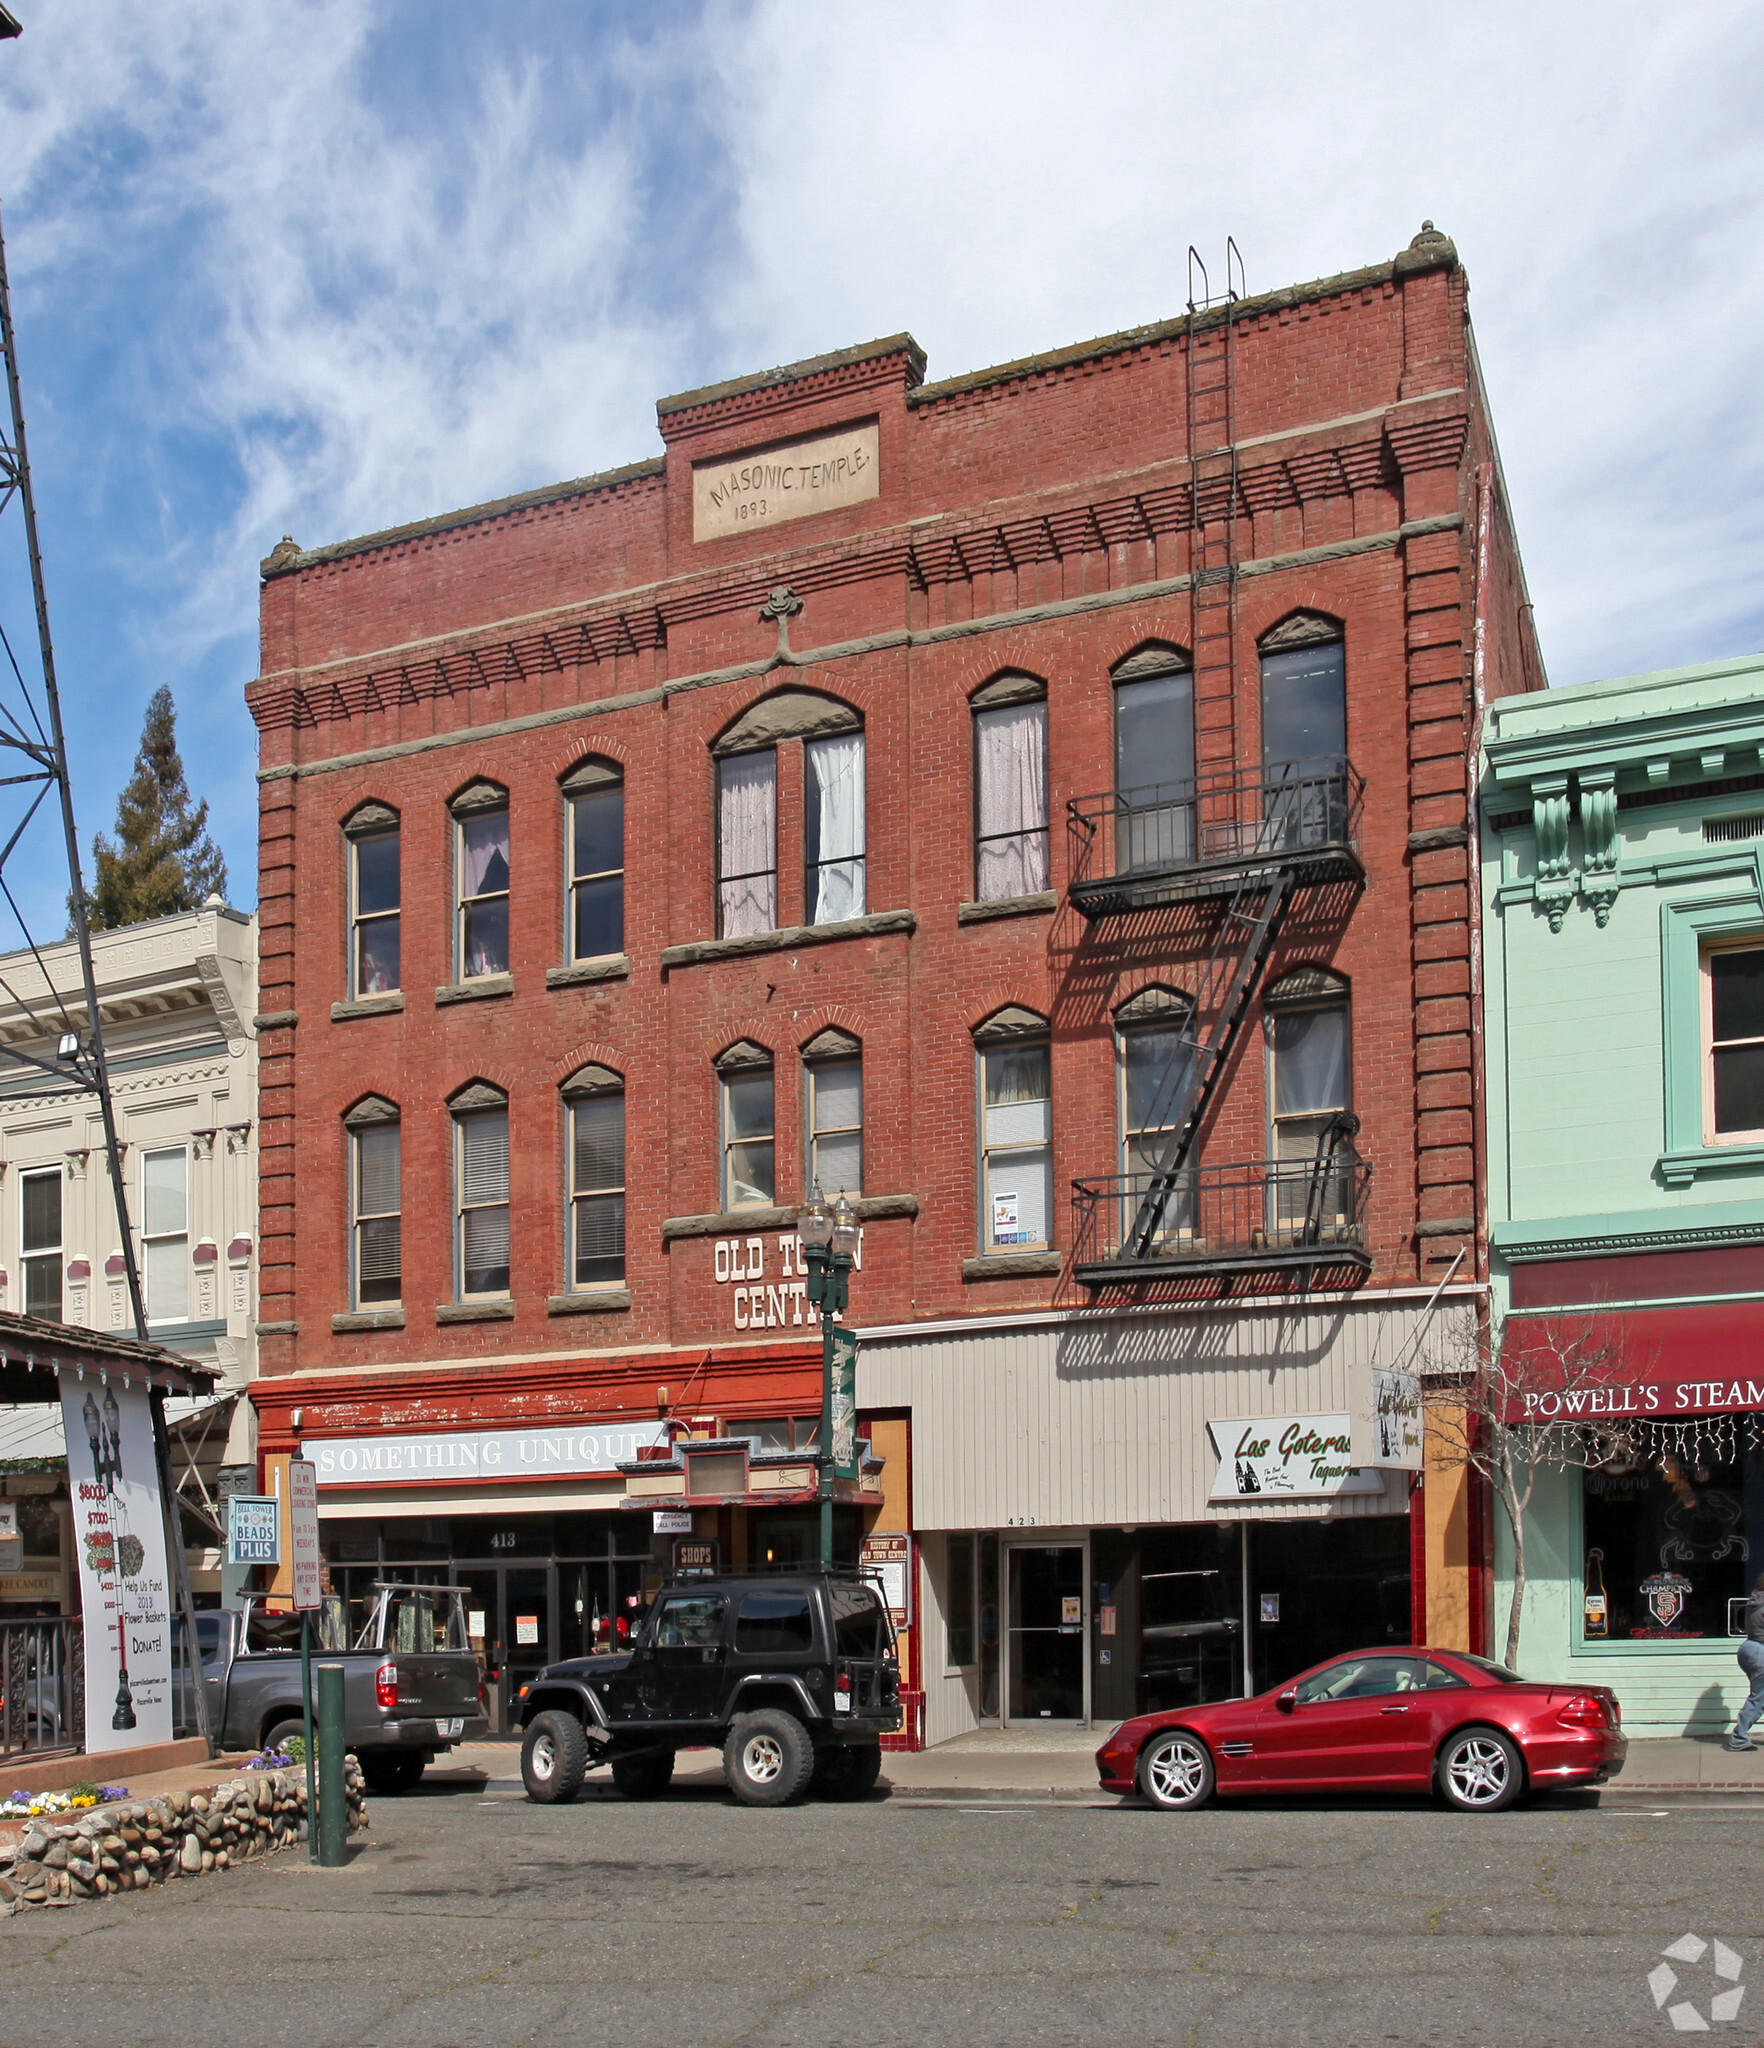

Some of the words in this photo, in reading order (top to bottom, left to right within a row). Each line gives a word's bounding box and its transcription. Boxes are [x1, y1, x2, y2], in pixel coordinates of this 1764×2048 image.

[714, 1237, 764, 1283] OLD
[778, 1227, 864, 1278] TON
[734, 1282, 843, 1330] CENT
[1523, 1385, 1659, 1417] POWELL'S
[1234, 1426, 1271, 1459] Las
[320, 1441, 502, 1473] SOMETHING
[519, 1433, 648, 1464] UNIQUE
[293, 1486, 314, 1496] COMMERCIAL
[237, 1505, 251, 1514] BELL
[252, 1505, 273, 1515] TOWER
[292, 1499, 306, 1508] LOADING
[307, 1499, 316, 1508] ZONE
[88, 1511, 108, 1526] $7000
[657, 1512, 688, 1520] EMERGENCY
[237, 1526, 273, 1540] BEADS
[490, 1532, 516, 1548] 413
[240, 1542, 272, 1558] PLUS
[681, 1546, 712, 1564] SHOPS
[862, 1551, 871, 1560] OLD
[873, 1551, 886, 1560] TOWN
[296, 1562, 301, 1570] NO
[302, 1561, 317, 1570] PARKING
[16, 1578, 49, 1590] CANDLE
[305, 1574, 316, 1583] OTHER
[125, 1580, 139, 1595] Help
[140, 1579, 147, 1592] Us
[149, 1579, 162, 1592] Fund
[303, 1586, 311, 1596] TIME
[1639, 1583, 1693, 1595] CHAMPIONS
[138, 1596, 153, 1609] 2013
[125, 1612, 143, 1624] Flower
[145, 1611, 166, 1623] Baskets
